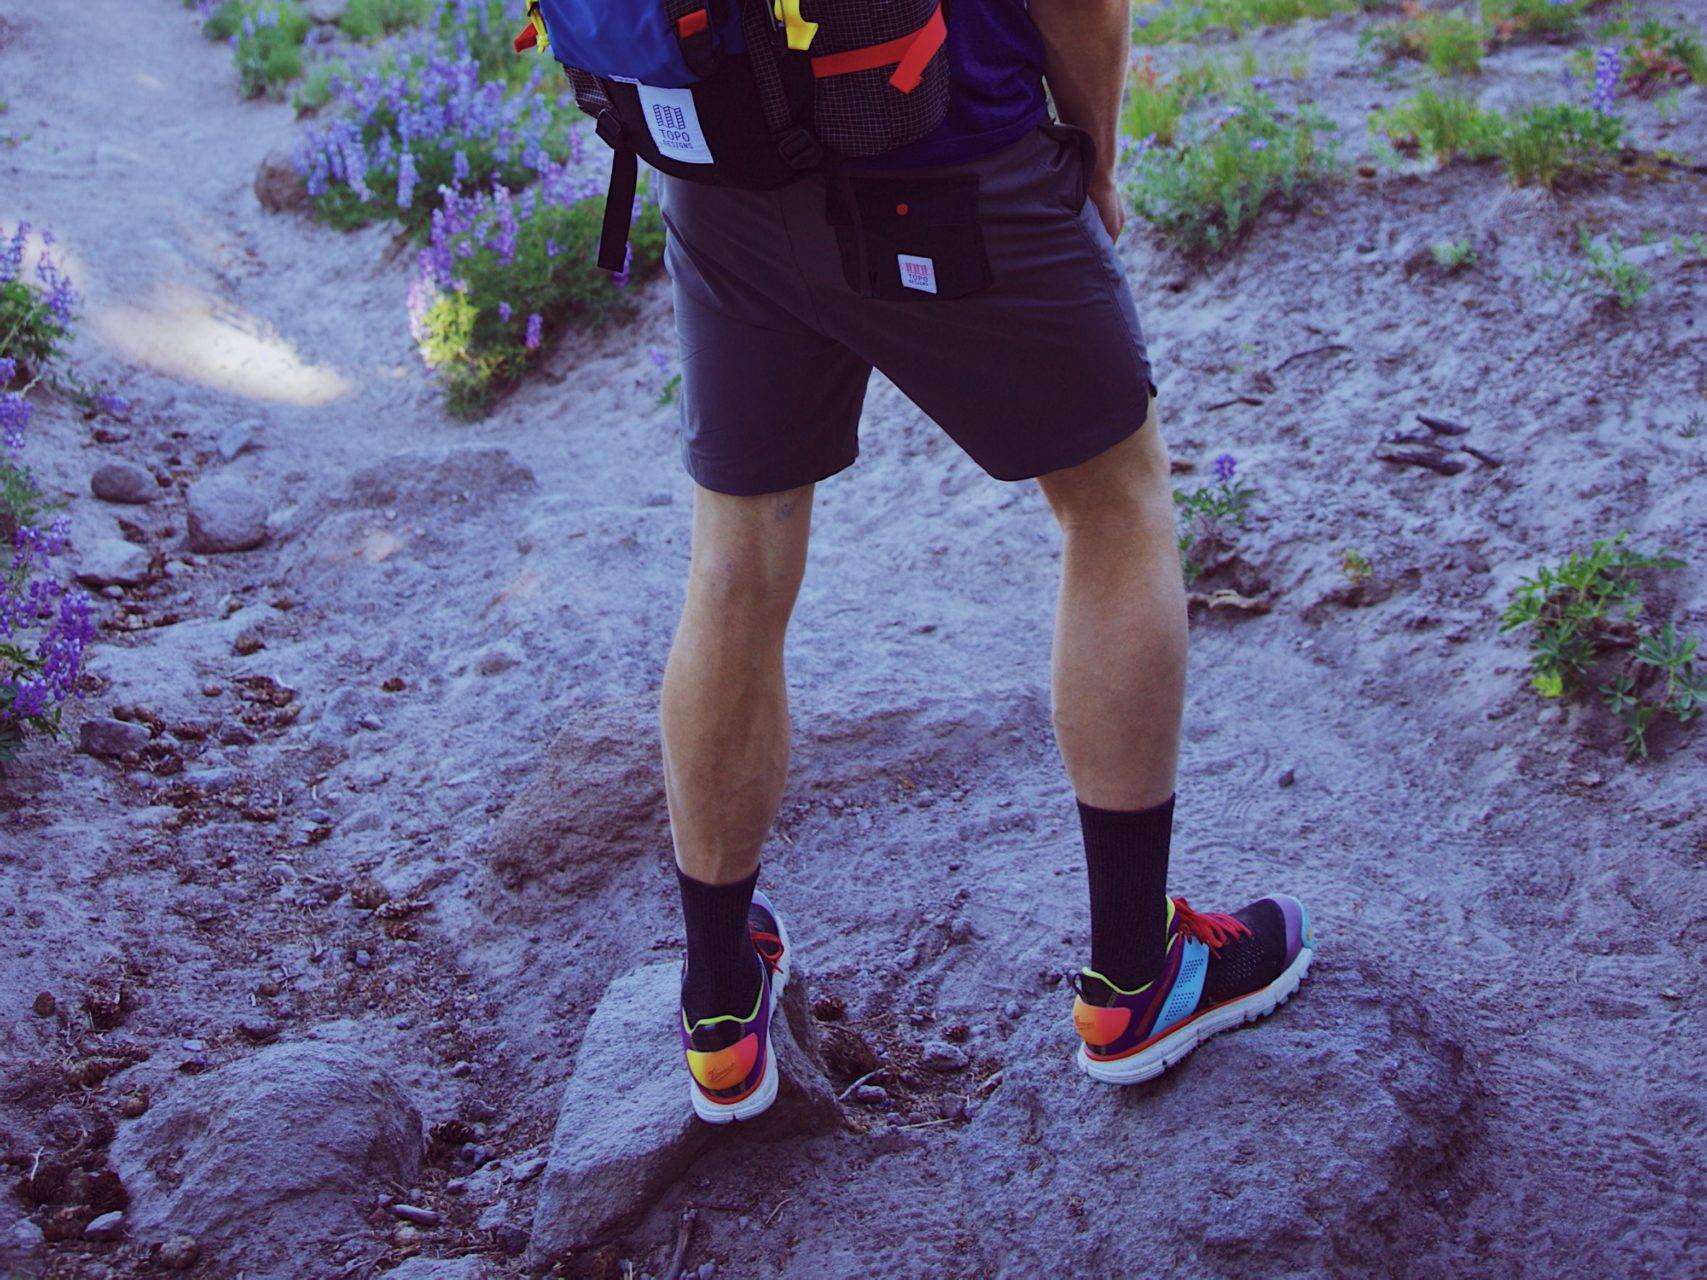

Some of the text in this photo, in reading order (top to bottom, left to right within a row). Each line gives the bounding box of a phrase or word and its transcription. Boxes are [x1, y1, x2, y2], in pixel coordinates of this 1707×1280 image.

[660, 129, 690, 142] TOPO
[662, 139, 693, 149] DESIGNS
[909, 273, 929, 282] TOPO
